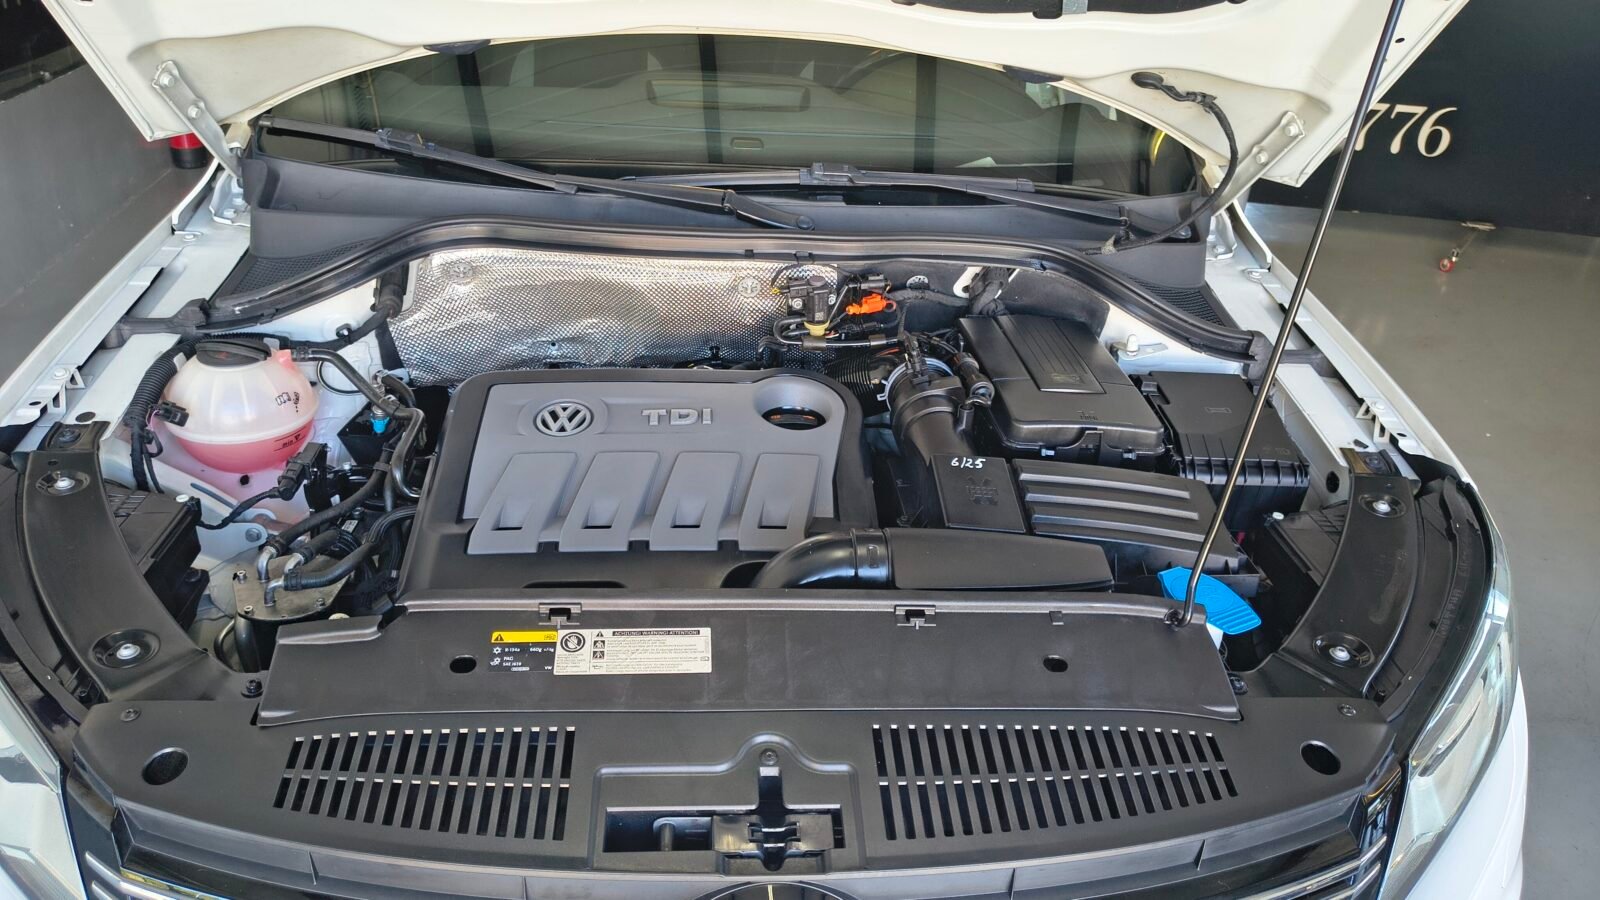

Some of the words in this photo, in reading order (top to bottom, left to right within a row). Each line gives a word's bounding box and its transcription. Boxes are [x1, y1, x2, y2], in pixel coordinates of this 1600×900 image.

[1354, 102, 1458, 158] 776
[641, 407, 713, 426] TDI
[950, 456, 987, 469] 6/25
